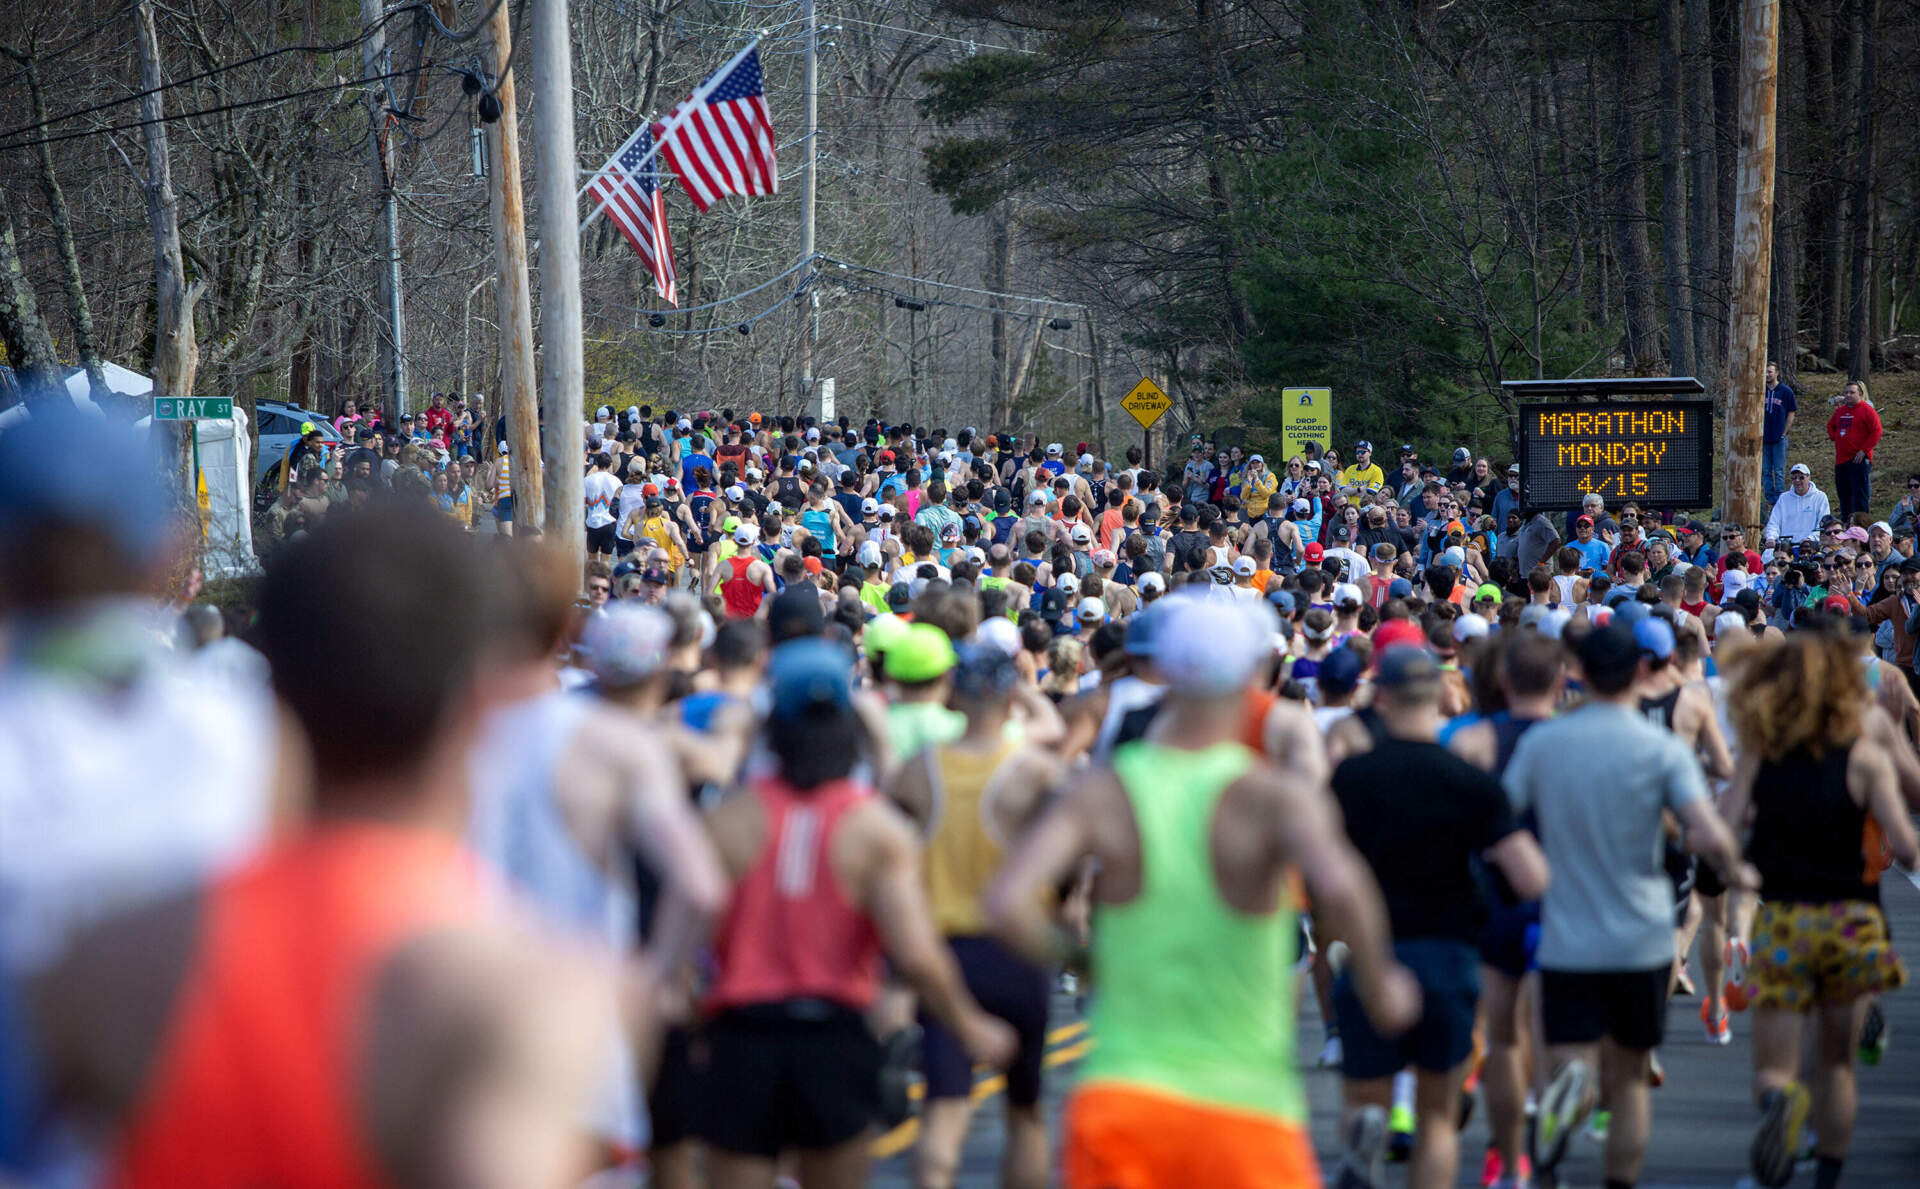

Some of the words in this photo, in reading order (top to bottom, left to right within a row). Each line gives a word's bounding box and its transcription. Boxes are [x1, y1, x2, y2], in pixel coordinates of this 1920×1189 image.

[1128, 402, 1167, 410] DRIVEWAY
[1137, 392, 1159, 400] BLIND
[177, 400, 206, 417] RAY
[217, 404, 229, 413] ST
[1540, 411, 1684, 435] MARATHON
[1558, 442, 1666, 466] MONDAY
[1577, 473, 1648, 496] 4/15
